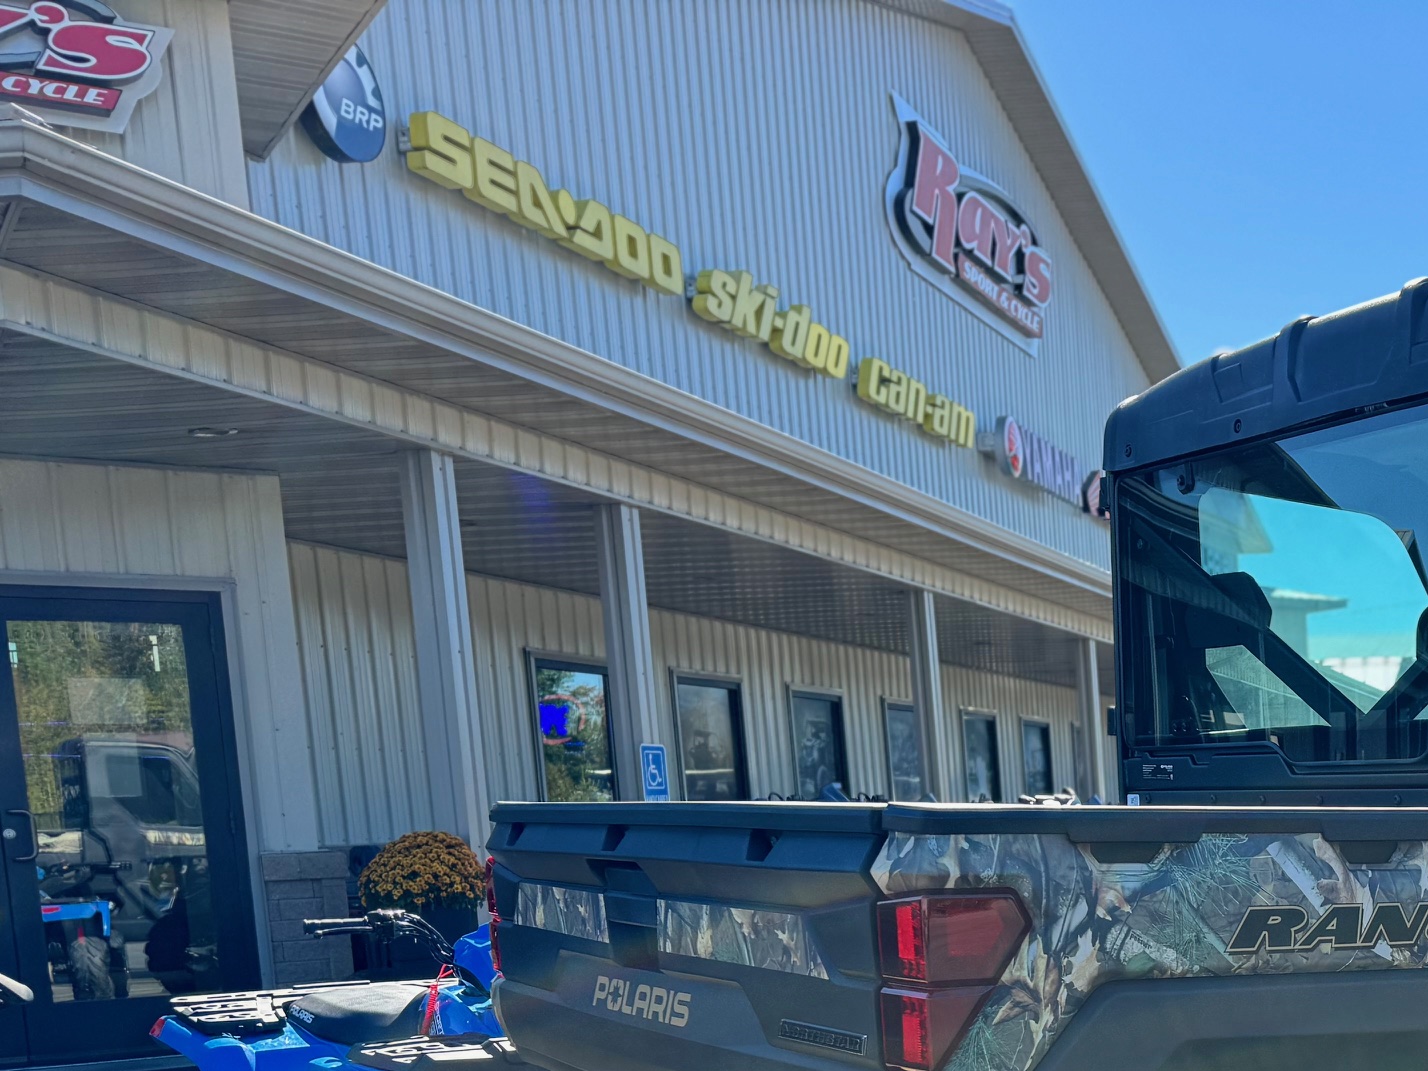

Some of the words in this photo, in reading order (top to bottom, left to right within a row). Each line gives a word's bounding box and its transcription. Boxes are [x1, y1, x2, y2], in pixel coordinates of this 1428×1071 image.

[1, 76, 108, 105] CYCLE
[340, 97, 383, 132] BRP
[963, 260, 999, 302] SPORT
[1000, 293, 1010, 310] &
[1010, 298, 1040, 333] CYCLE
[1020, 425, 1084, 507] YAMAHA
[290, 1004, 315, 1024] POLARIS
[592, 975, 692, 1028] POLARIS
[781, 1023, 861, 1051] NORTHSTAR
